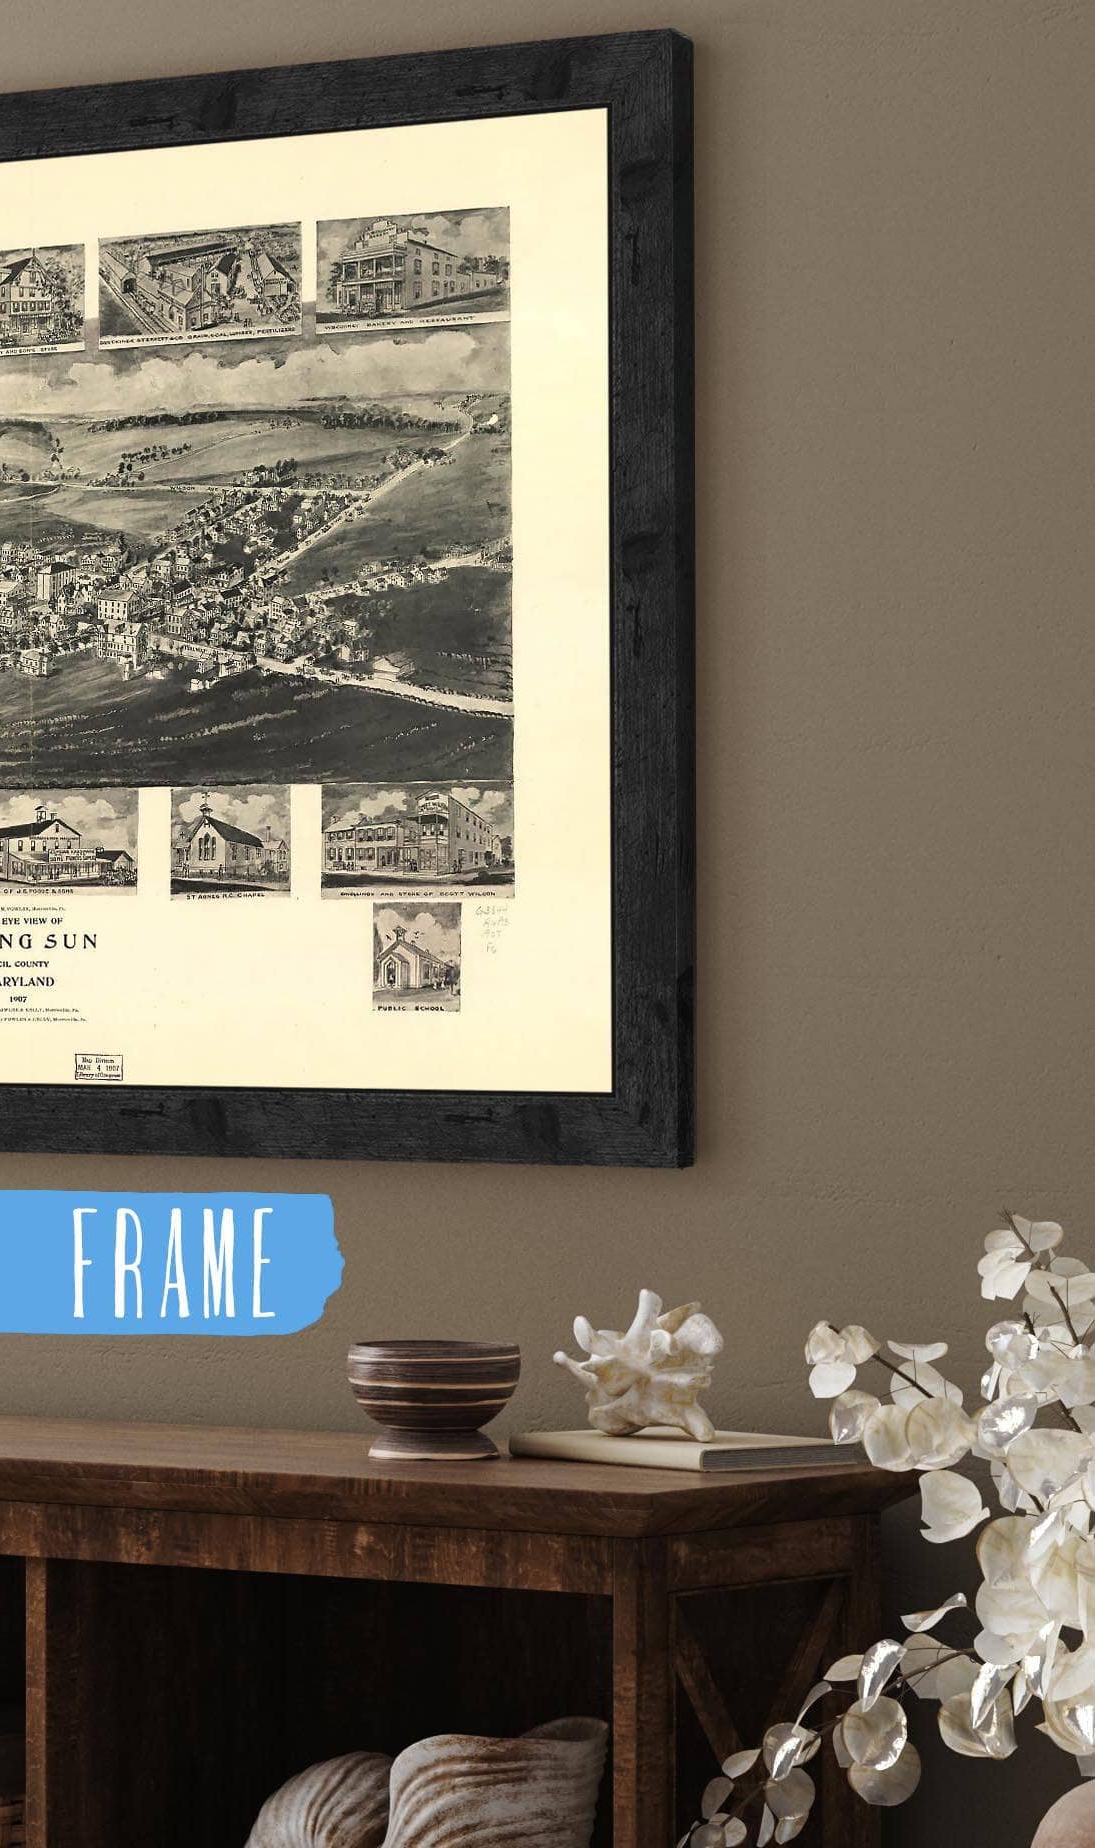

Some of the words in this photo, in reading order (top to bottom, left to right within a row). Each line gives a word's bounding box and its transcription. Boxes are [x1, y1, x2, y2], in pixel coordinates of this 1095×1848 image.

[419, 315, 475, 324] RESTAURANT
[2, 917, 20, 925] EYE
[23, 917, 47, 925] VIEW
[51, 917, 63, 925] OF
[43, 933, 98, 949] SUN
[14, 960, 50, 968] COUNTY
[9, 995, 28, 1003] 1907
